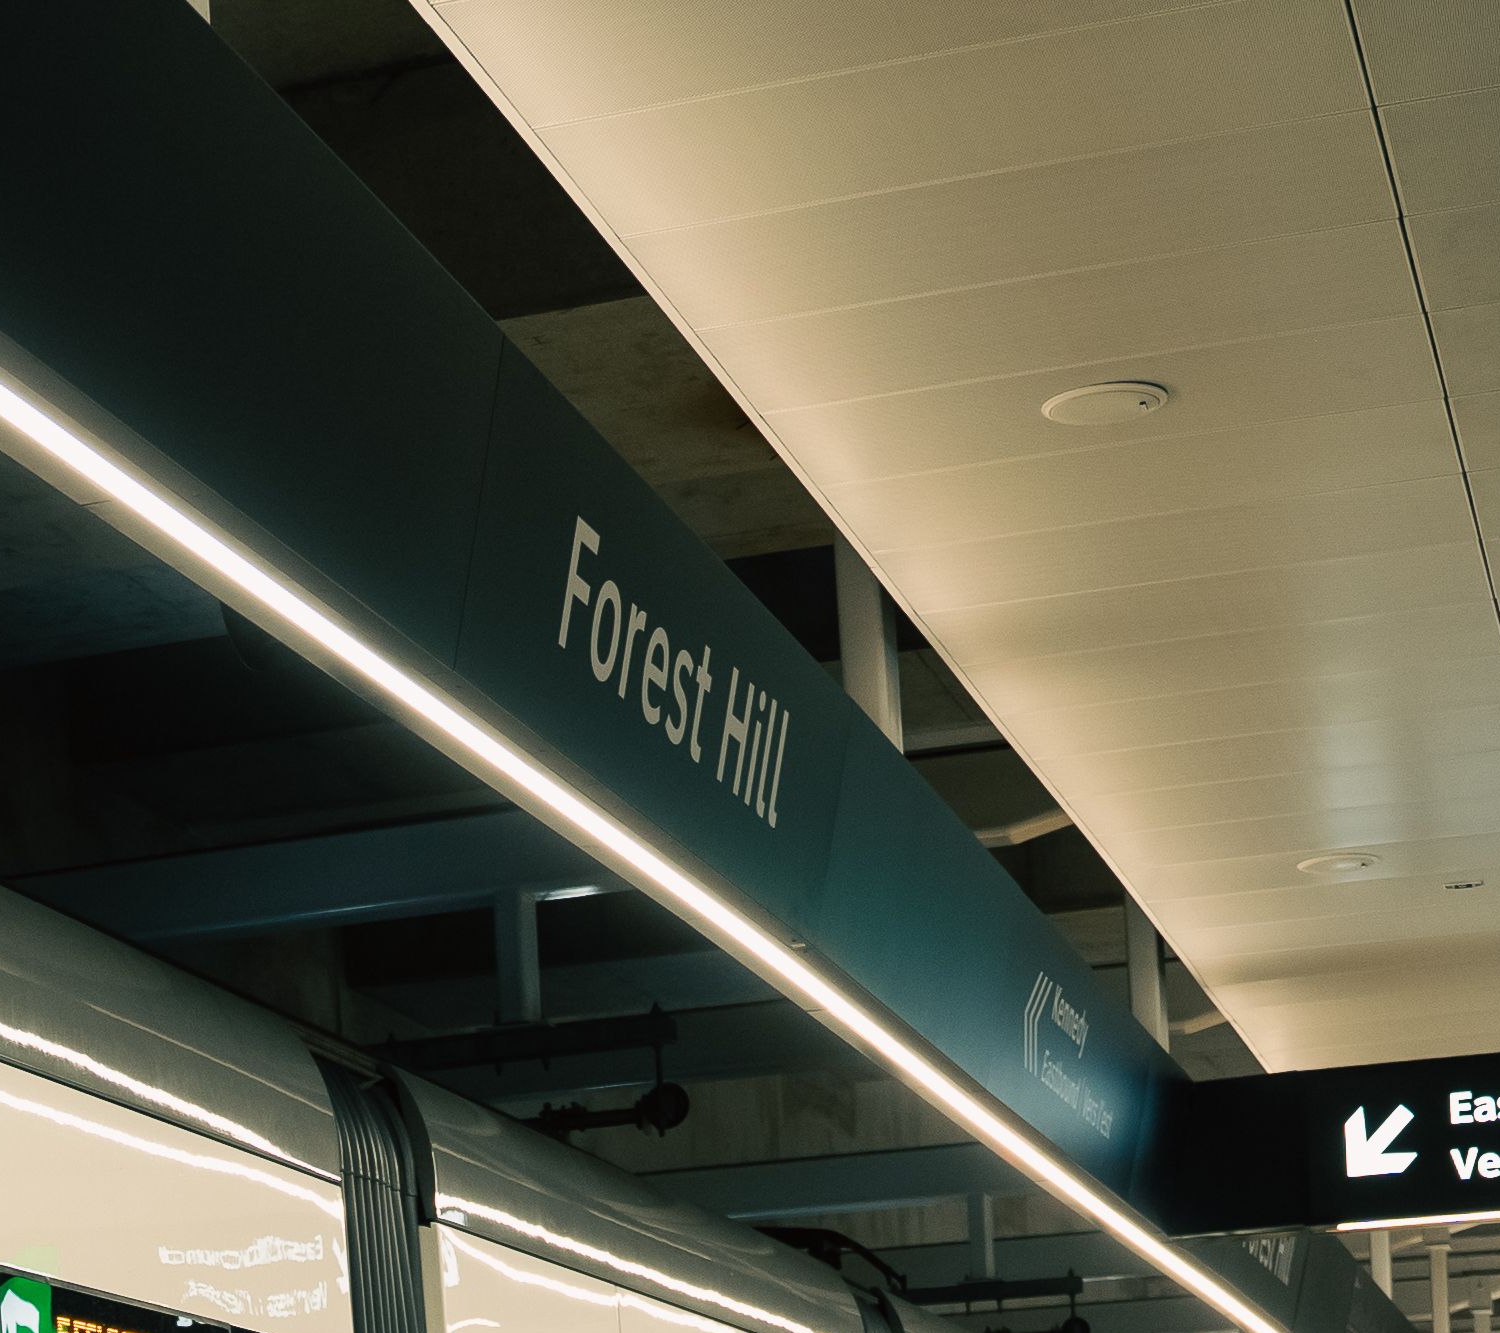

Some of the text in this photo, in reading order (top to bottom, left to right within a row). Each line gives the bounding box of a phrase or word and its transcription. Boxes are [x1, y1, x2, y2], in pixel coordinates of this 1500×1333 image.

[557, 514, 790, 830] Forest Hill
[1051, 983, 1089, 1059] Kennedy
